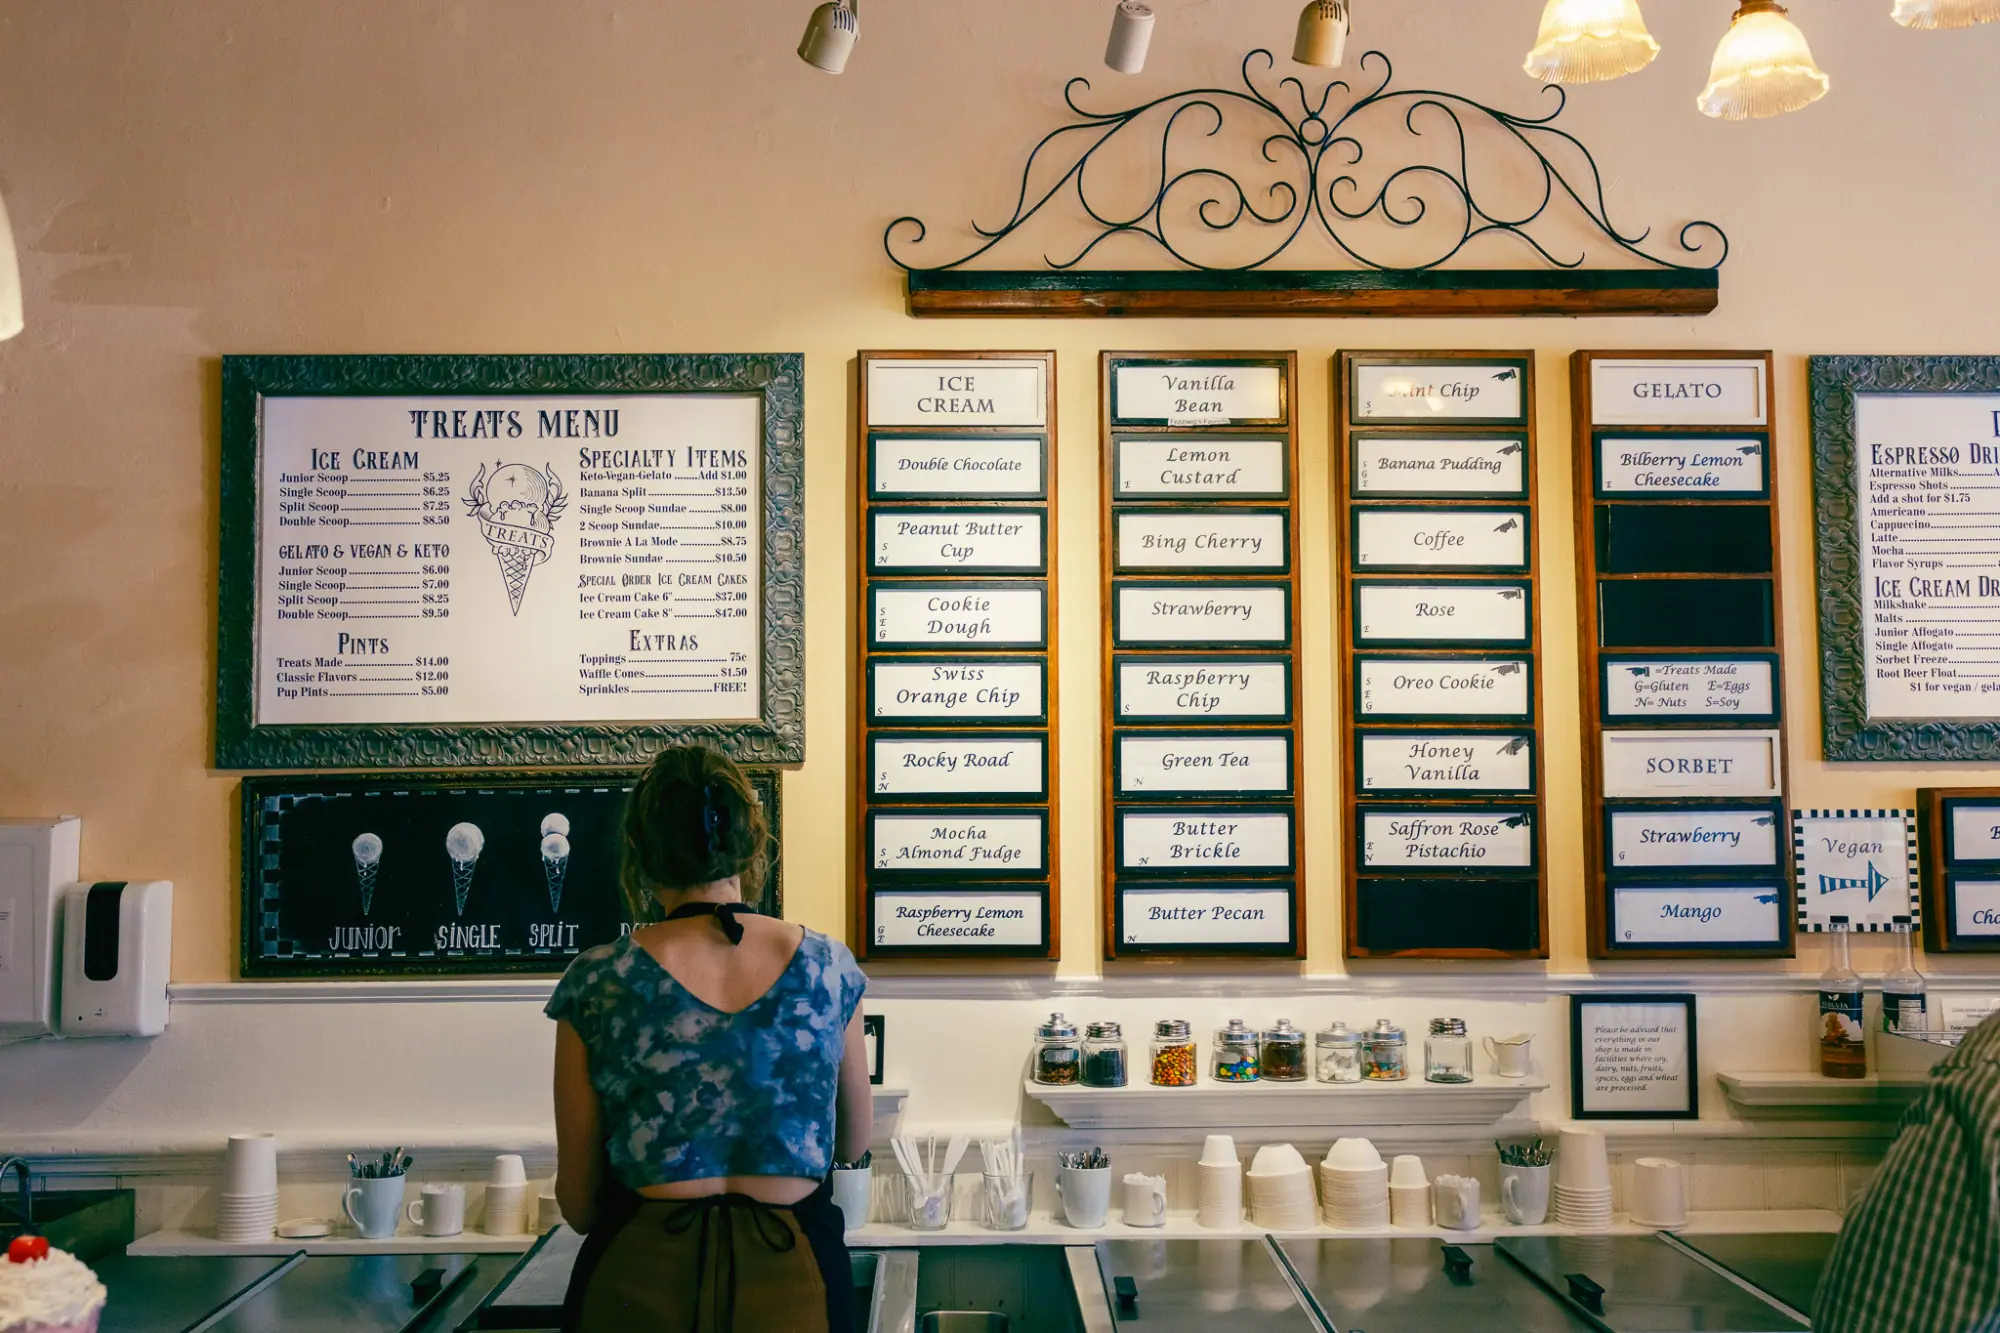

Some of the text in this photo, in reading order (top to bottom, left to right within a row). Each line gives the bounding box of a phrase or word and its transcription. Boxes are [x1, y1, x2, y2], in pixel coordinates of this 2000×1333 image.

[938, 376, 975, 391] ICE
[1162, 375, 1236, 391] Vanilla
[1440, 382, 1480, 402] Chip
[1633, 383, 1722, 399] GELATO
[917, 397, 995, 413] CREAM
[1175, 400, 1223, 413] Bean
[408, 409, 619, 439] TREATS MENU
[1166, 448, 1231, 462] Lemon
[1620, 452, 1743, 470] Bilberry Lemon
[898, 458, 1022, 471] Double Chocolate
[1378, 457, 1502, 474] Banana Pudding
[279, 472, 450, 484] Junior Scoop $5.25
[580, 471, 747, 482] Keto-Vegan-Gelato Add $1.00
[1160, 469, 1241, 484] Custard
[1635, 472, 1720, 487] Cheesecake
[1869, 468, 1958, 478] Alternative Milks
[279, 487, 450, 499] Single Scoop $6.25
[580, 487, 747, 499] Banana Split $13.50
[1870, 480, 1948, 492] Espresso Shots
[1870, 494, 1889, 503] Add
[1902, 494, 1923, 503] shot
[1926, 494, 1941, 503] for
[1944, 493, 1970, 503] $1.75
[279, 501, 450, 513] Split Scoop $7.25
[1871, 507, 1925, 516] Americano
[279, 516, 450, 528] Double Scoop $8.50
[898, 522, 1022, 535] Peanut Butter
[1870, 520, 1930, 531] Cappuccino
[485, 523, 549, 549] TREATS
[1142, 533, 1262, 553] Bing Cherry
[1414, 531, 1465, 550] Coffee
[1872, 533, 1898, 542] Latte
[279, 544, 449, 559] GELATO & VEGAN & KETO
[941, 544, 974, 561] Cup
[1872, 546, 1904, 555] Mocha
[1872, 559, 1943, 570] Flavor Syrups
[928, 596, 990, 612] Cookie
[1152, 600, 1252, 620] Strawberry
[1415, 603, 1455, 617] Rose
[1874, 600, 1926, 609] Milkshake
[1874, 614, 1903, 622] Malts
[928, 618, 991, 638] Dough
[277, 657, 448, 668] Treats Made $14.00
[579, 654, 626, 665] Toppings
[277, 671, 448, 682] Classic Flavors $12.00
[579, 668, 747, 679] Waffle Cones $1.50
[932, 665, 984, 681] Swiss
[1703, 664, 1738, 675] Made
[1147, 669, 1250, 690] Raspberry
[1393, 674, 1494, 690] Oreo Cookie
[277, 686, 448, 699] Pup Pints $5.00
[579, 682, 747, 696] Sprinkles FREE!
[896, 687, 1020, 708] Orange Chip
[1177, 692, 1220, 712] Chip
[1657, 697, 1687, 707] Nuts
[1409, 742, 1474, 762] Honey
[903, 751, 1014, 772] Rocky Road
[1162, 752, 1250, 770] Green Tea
[1647, 758, 1733, 774] SORBET
[1404, 765, 1480, 780] Vanilla
[931, 826, 987, 840] Mocha
[1173, 821, 1238, 836] Butter
[1389, 820, 1499, 840] Saffron Rose
[1640, 827, 1740, 847] Strawberry
[896, 845, 1021, 862] Almond Fudge
[1170, 842, 1240, 858] Brickle
[1406, 842, 1486, 858] Pistachio
[1822, 837, 1883, 858] Vegan
[896, 905, 1024, 922] Raspberry Lemon
[1148, 906, 1265, 920] Butter Pecan
[1660, 904, 1722, 923] Mango
[917, 924, 995, 937] Cheesecake
